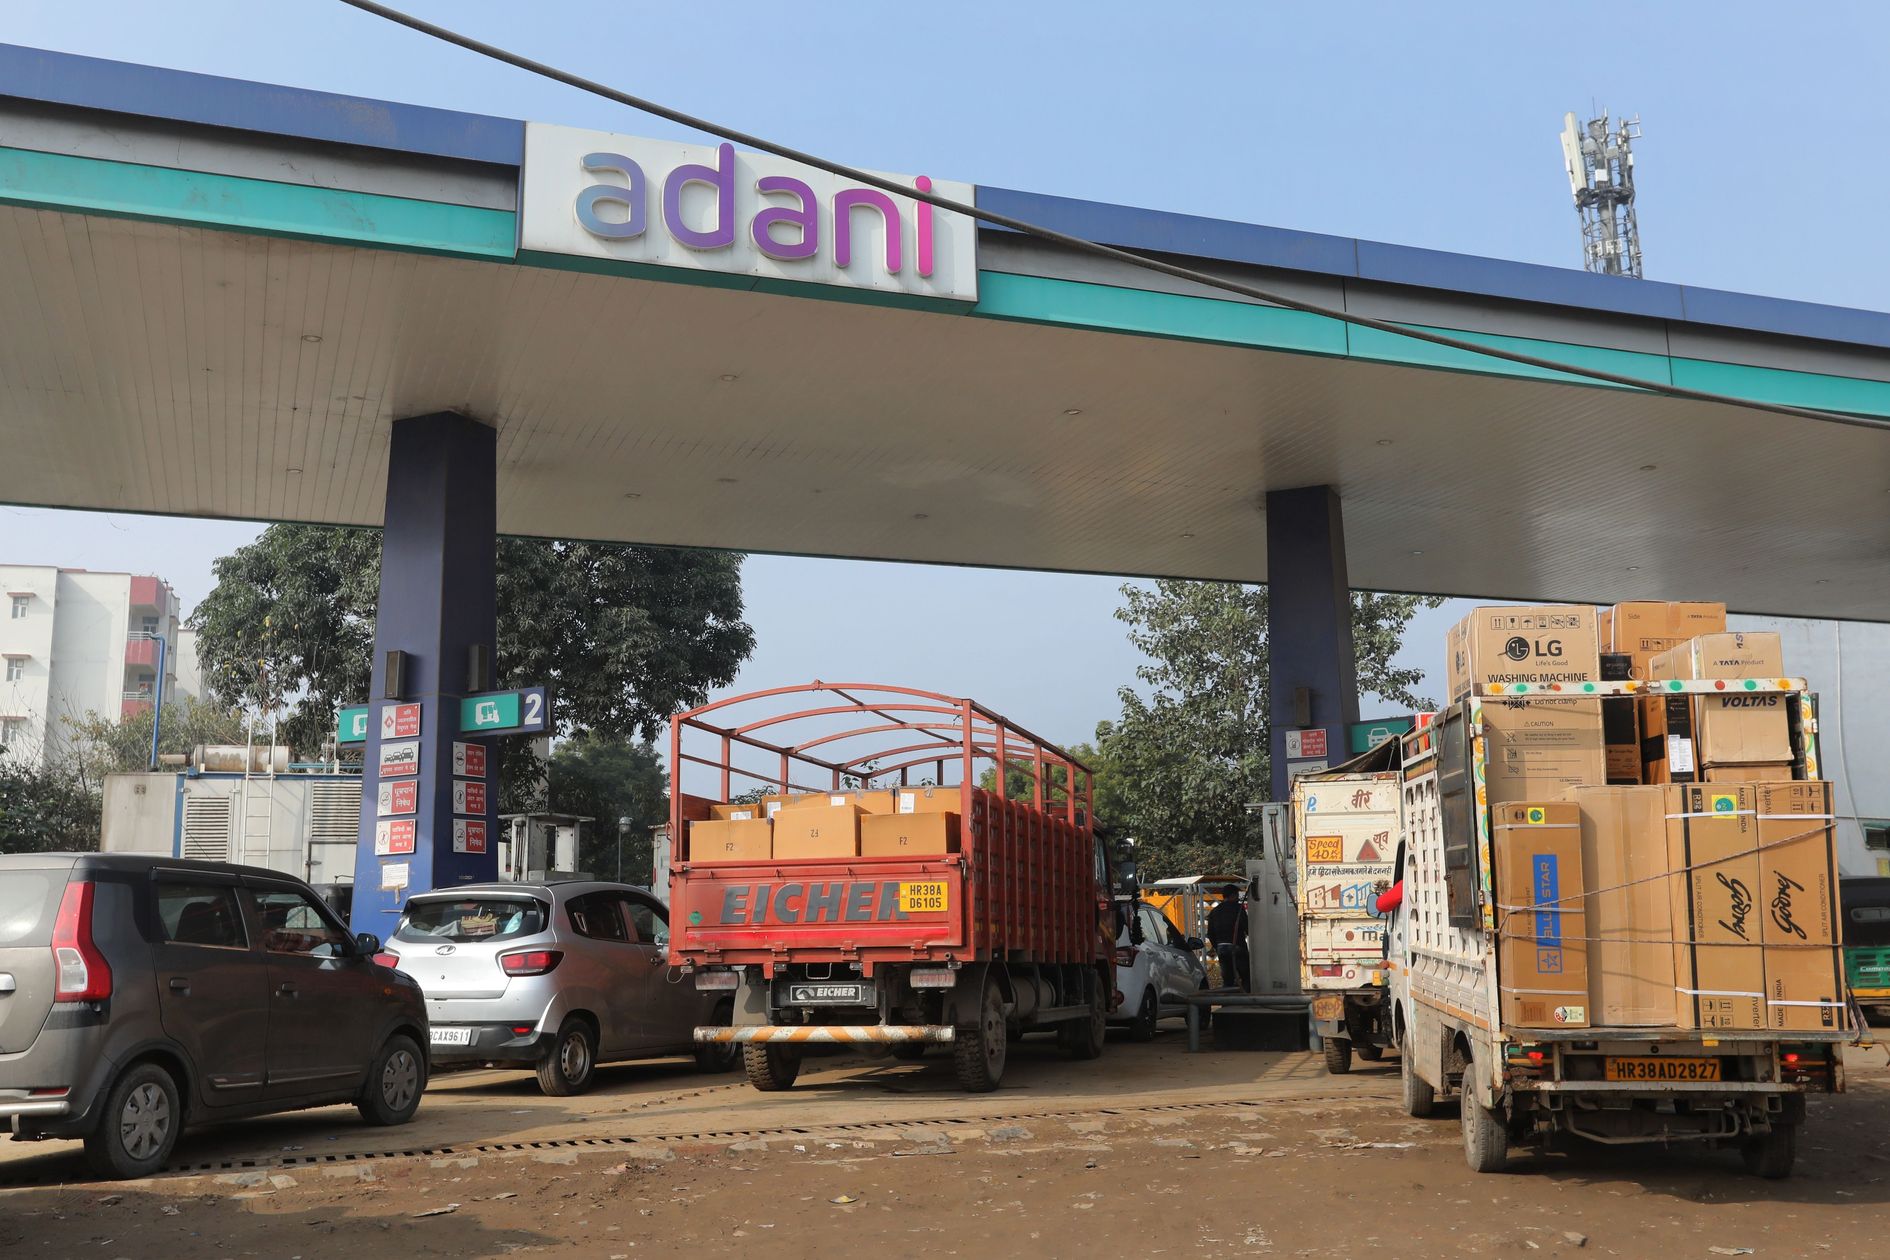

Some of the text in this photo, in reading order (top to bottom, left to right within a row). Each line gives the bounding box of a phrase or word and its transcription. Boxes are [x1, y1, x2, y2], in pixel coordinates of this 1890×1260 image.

[574, 142, 934, 277] adani
[1535, 640, 1562, 657] LG
[1487, 672, 1588, 683] WASHING MACHINE
[1722, 695, 1777, 708] VOLTAS
[524, 693, 542, 726] 2
[810, 829, 819, 838] F2
[899, 836, 908, 846] F2
[725, 842, 734, 851] F2
[1312, 849, 1330, 860] 40
[1540, 862, 1551, 898] STAR
[910, 885, 942, 896] HR38A
[720, 881, 909, 924] EICHER
[910, 897, 942, 908] D6105
[1716, 872, 1752, 941] Godrej
[1771, 870, 1807, 940] Godrej
[816, 987, 856, 997] EICHER
[1752, 997, 1760, 1029] nverter
[1616, 1062, 1717, 1079] HR38AD2827
